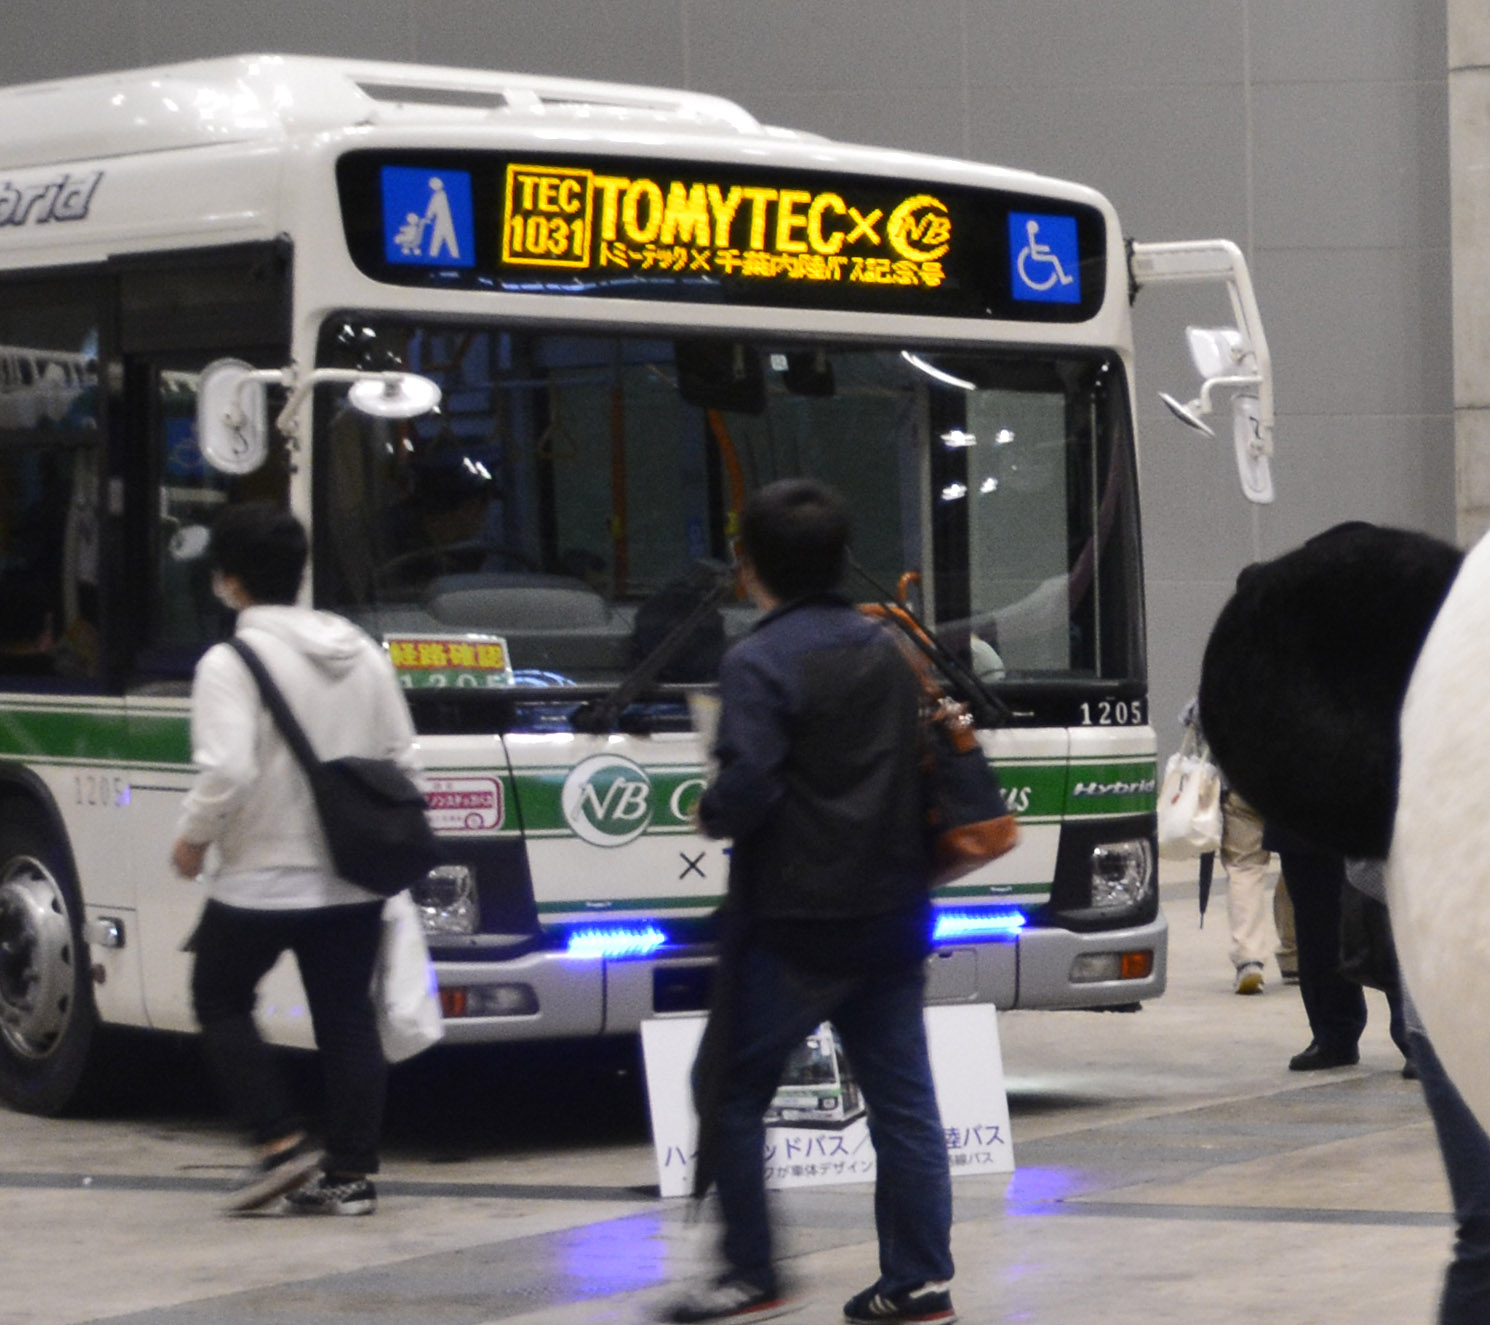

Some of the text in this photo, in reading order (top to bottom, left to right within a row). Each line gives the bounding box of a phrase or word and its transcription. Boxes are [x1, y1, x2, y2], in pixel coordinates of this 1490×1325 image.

[517, 174, 582, 214] TEC
[510, 213, 586, 257] 1031
[1080, 701, 1143, 725] 1205
[1073, 778, 1156, 796] Hybrid
